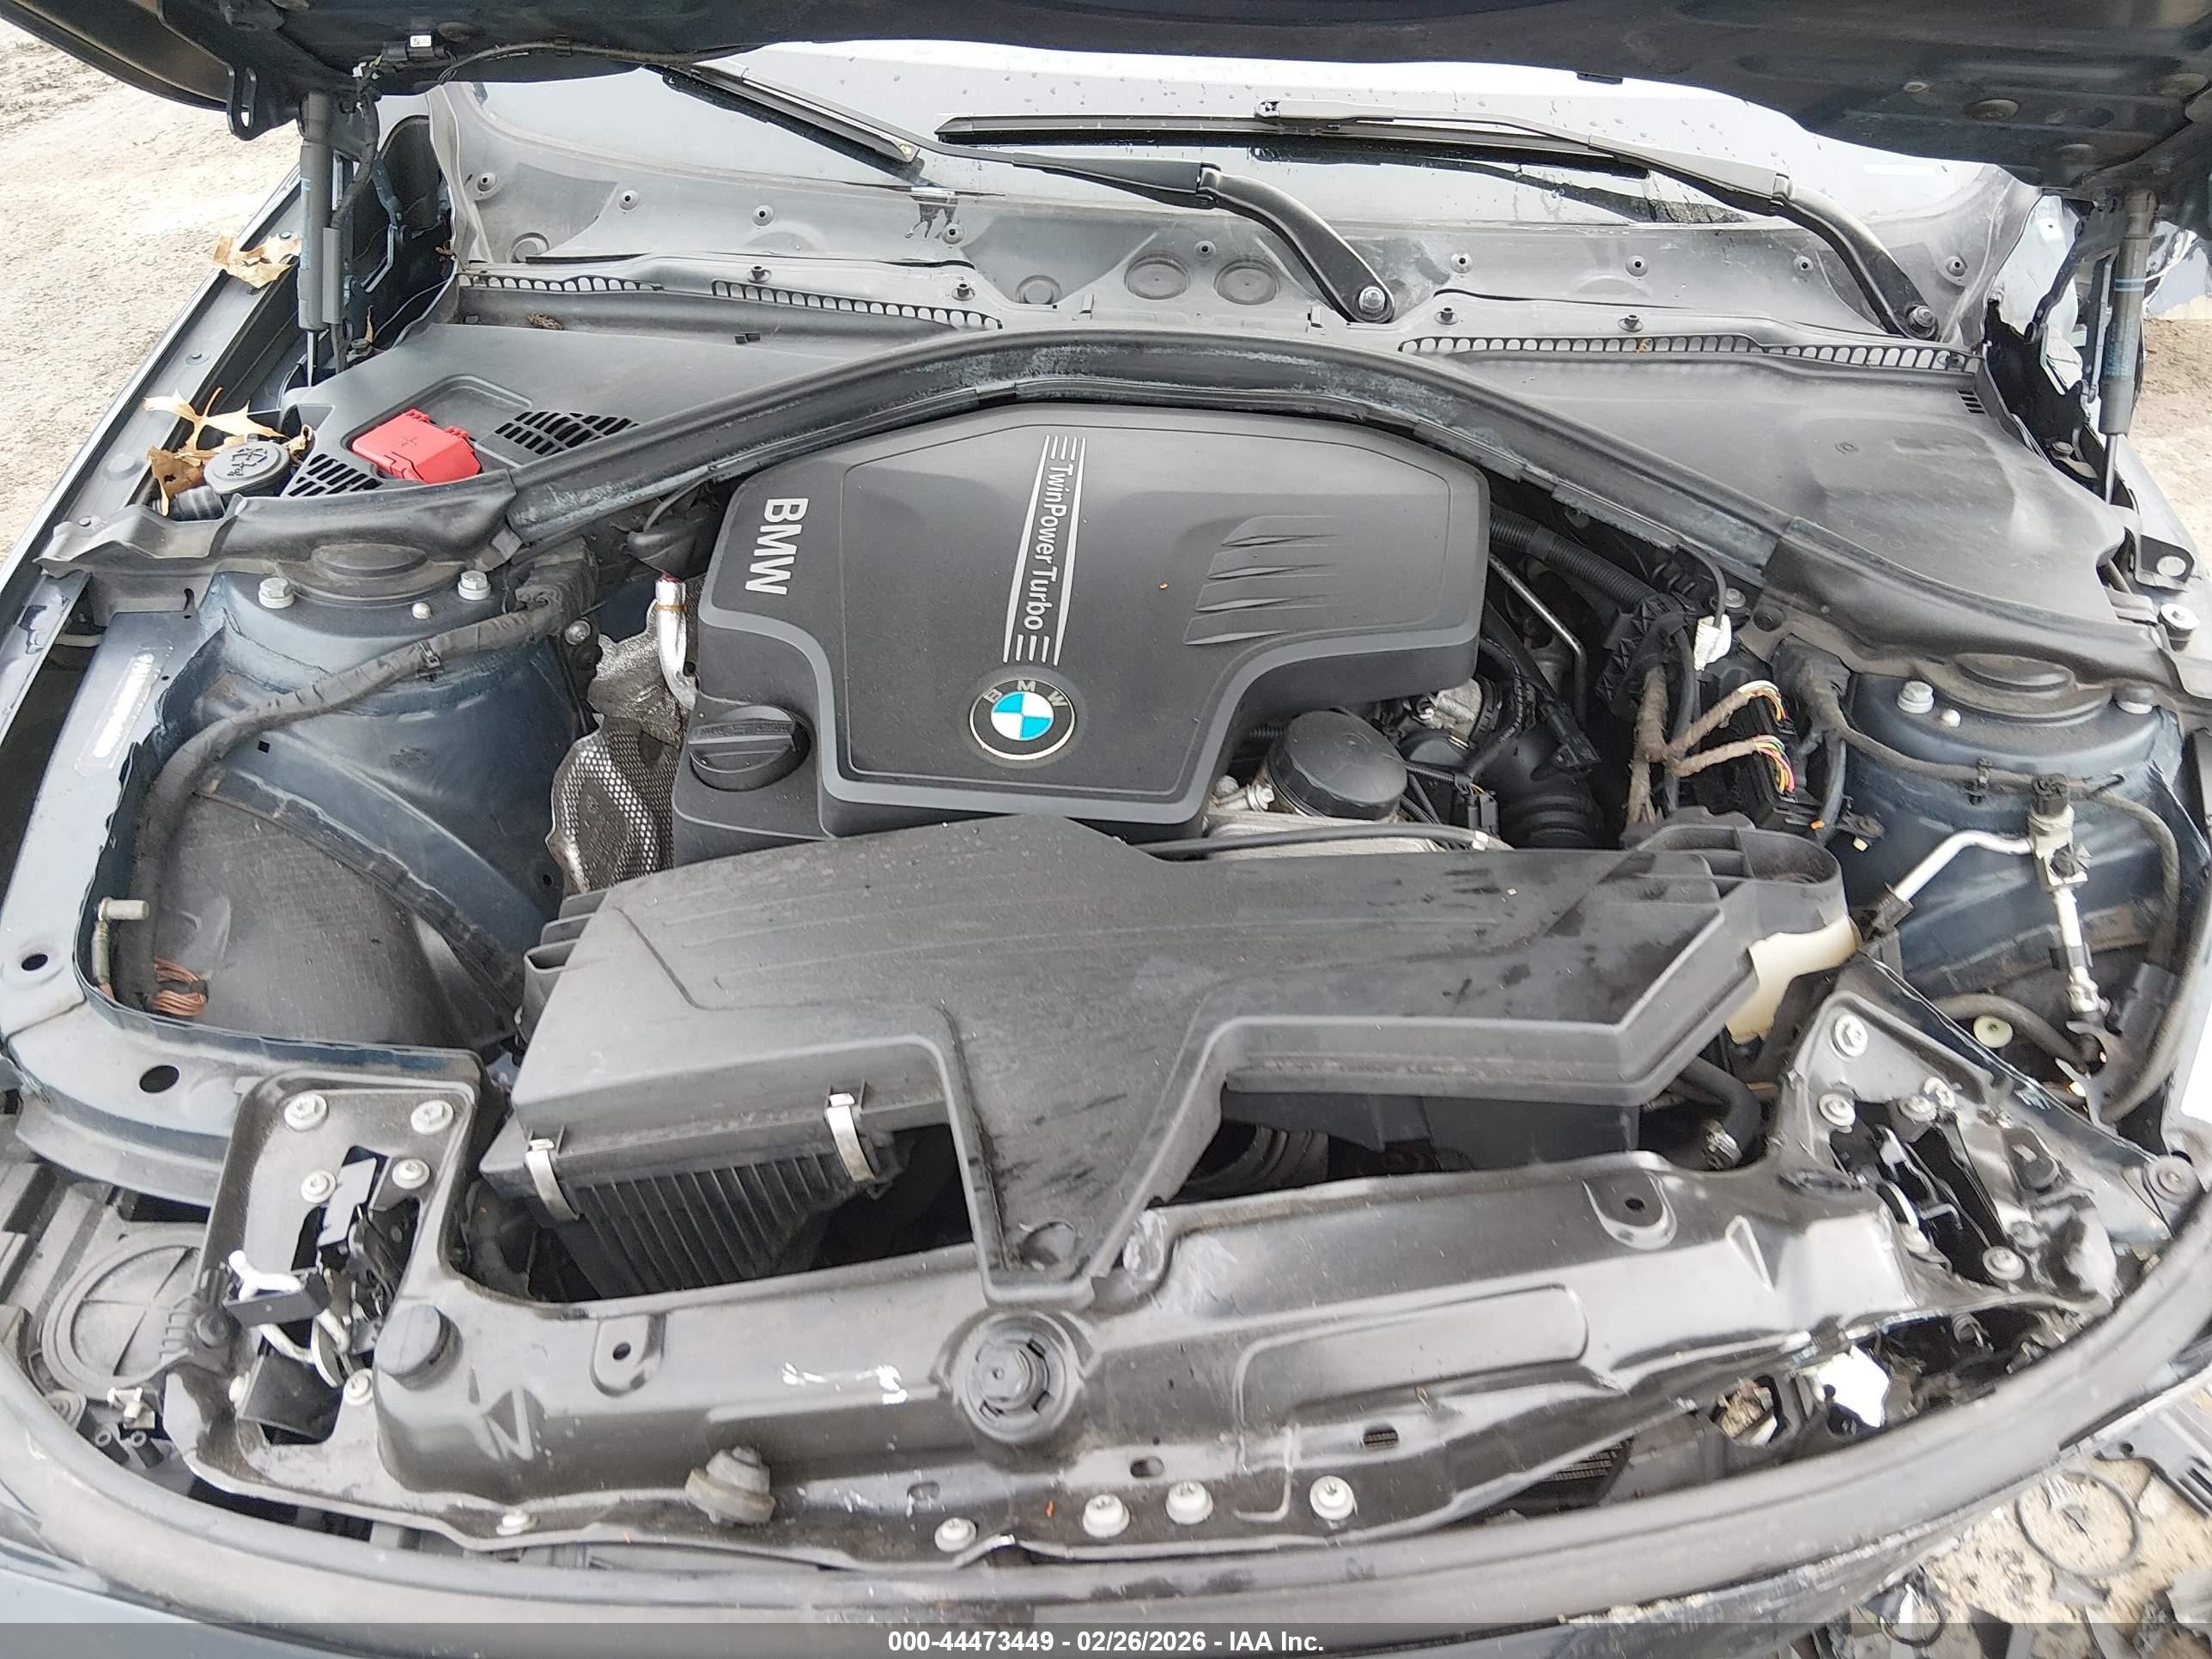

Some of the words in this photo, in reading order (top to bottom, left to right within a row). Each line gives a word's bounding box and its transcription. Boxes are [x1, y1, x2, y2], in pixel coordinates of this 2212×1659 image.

[744, 497, 810, 595] BMW
[1034, 463, 1074, 565] TwinPower
[1024, 565, 1058, 630] Turbo
[983, 679, 1068, 708] BMW
